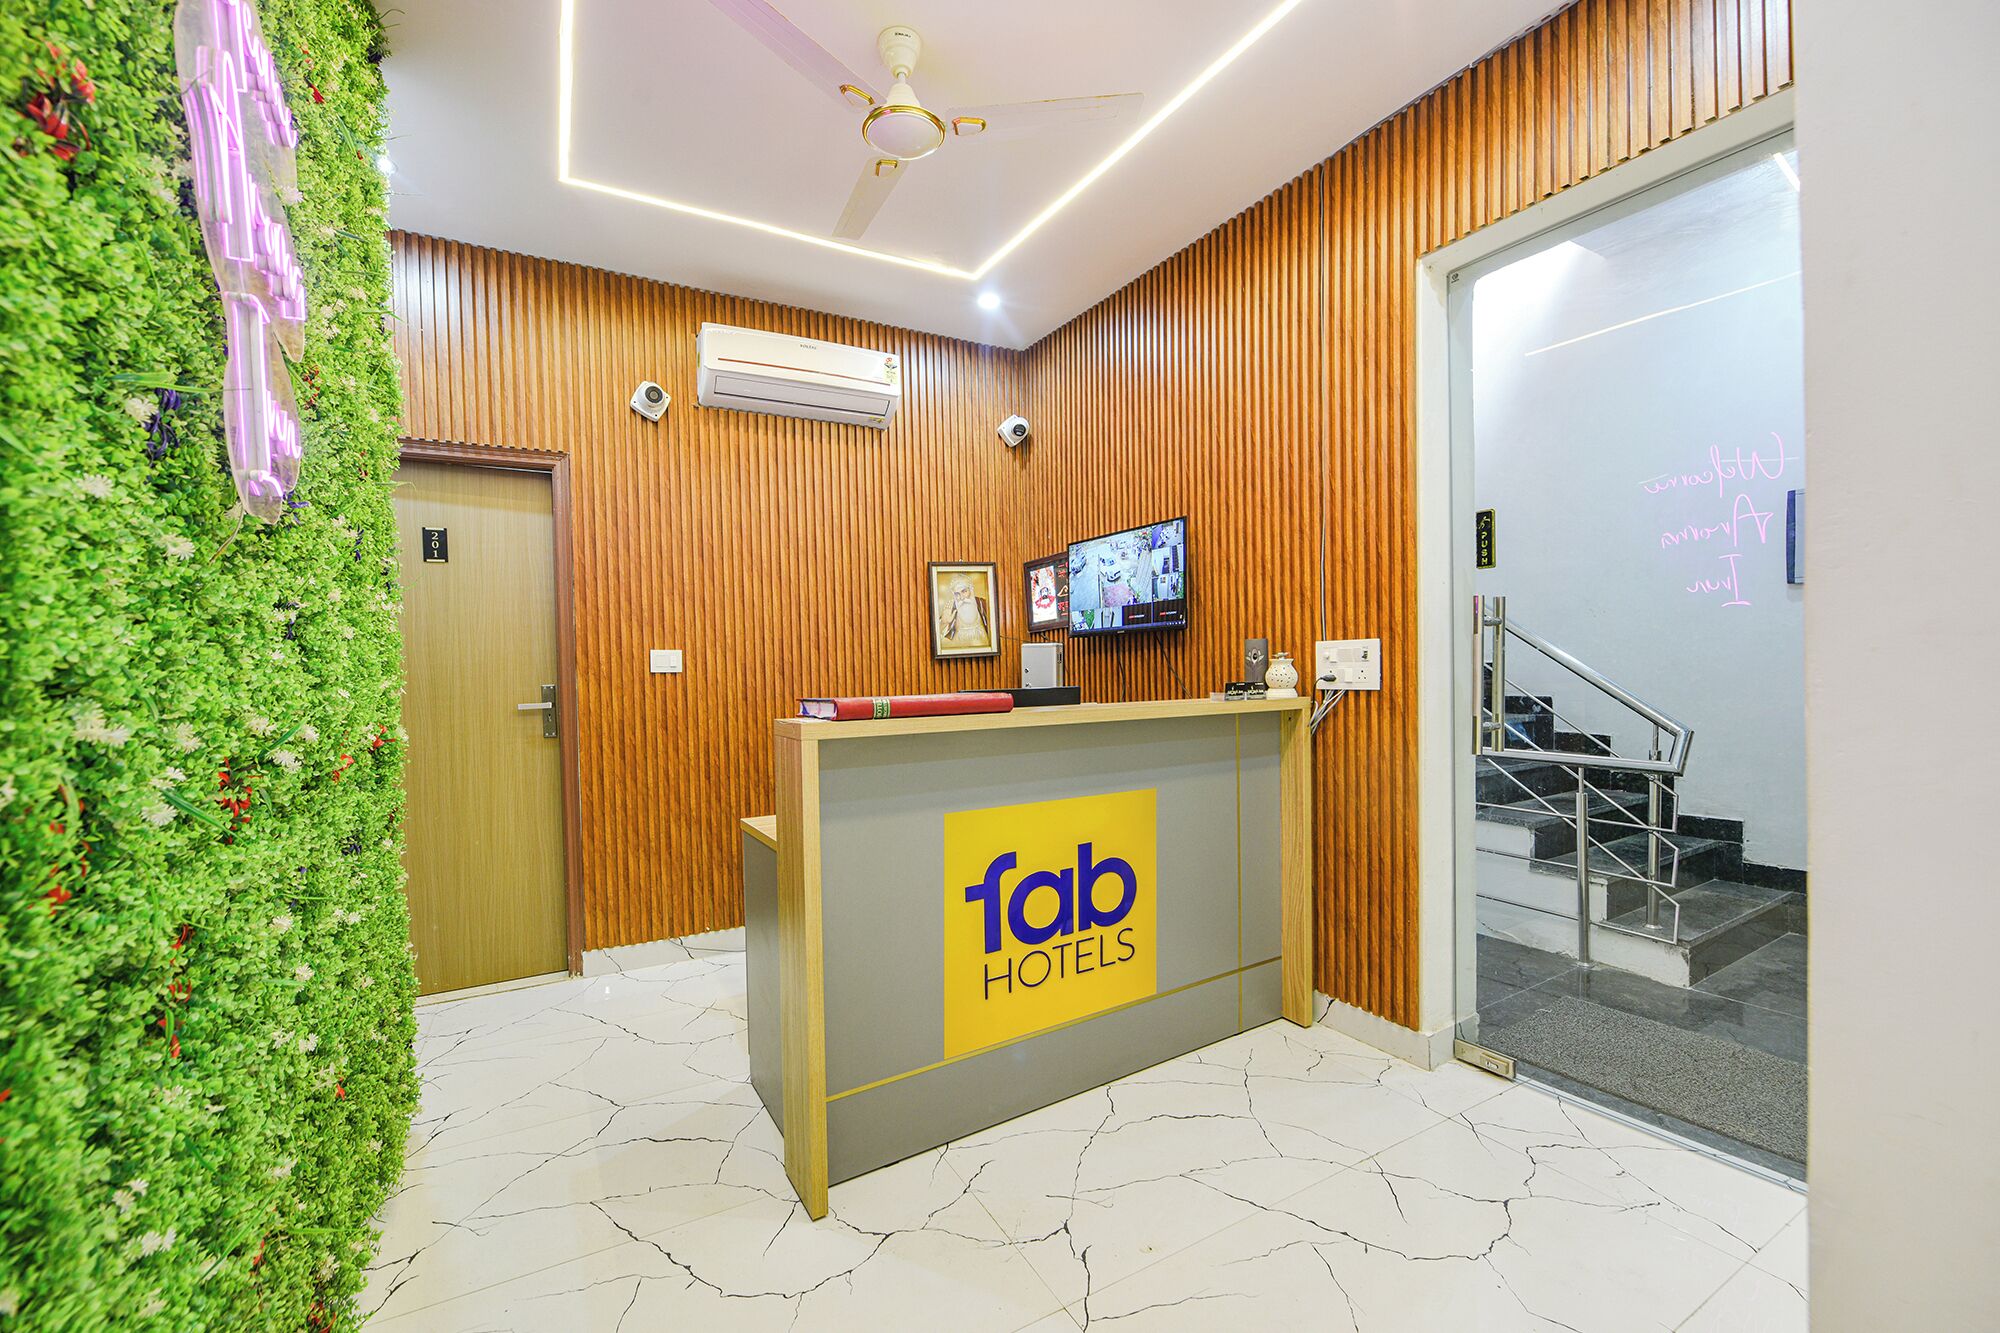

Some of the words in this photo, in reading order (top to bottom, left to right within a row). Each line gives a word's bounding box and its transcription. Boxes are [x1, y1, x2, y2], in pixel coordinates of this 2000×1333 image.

[431, 531, 440, 558] 201
[965, 842, 1137, 954] fab
[984, 927, 1136, 1000] HOTELS
